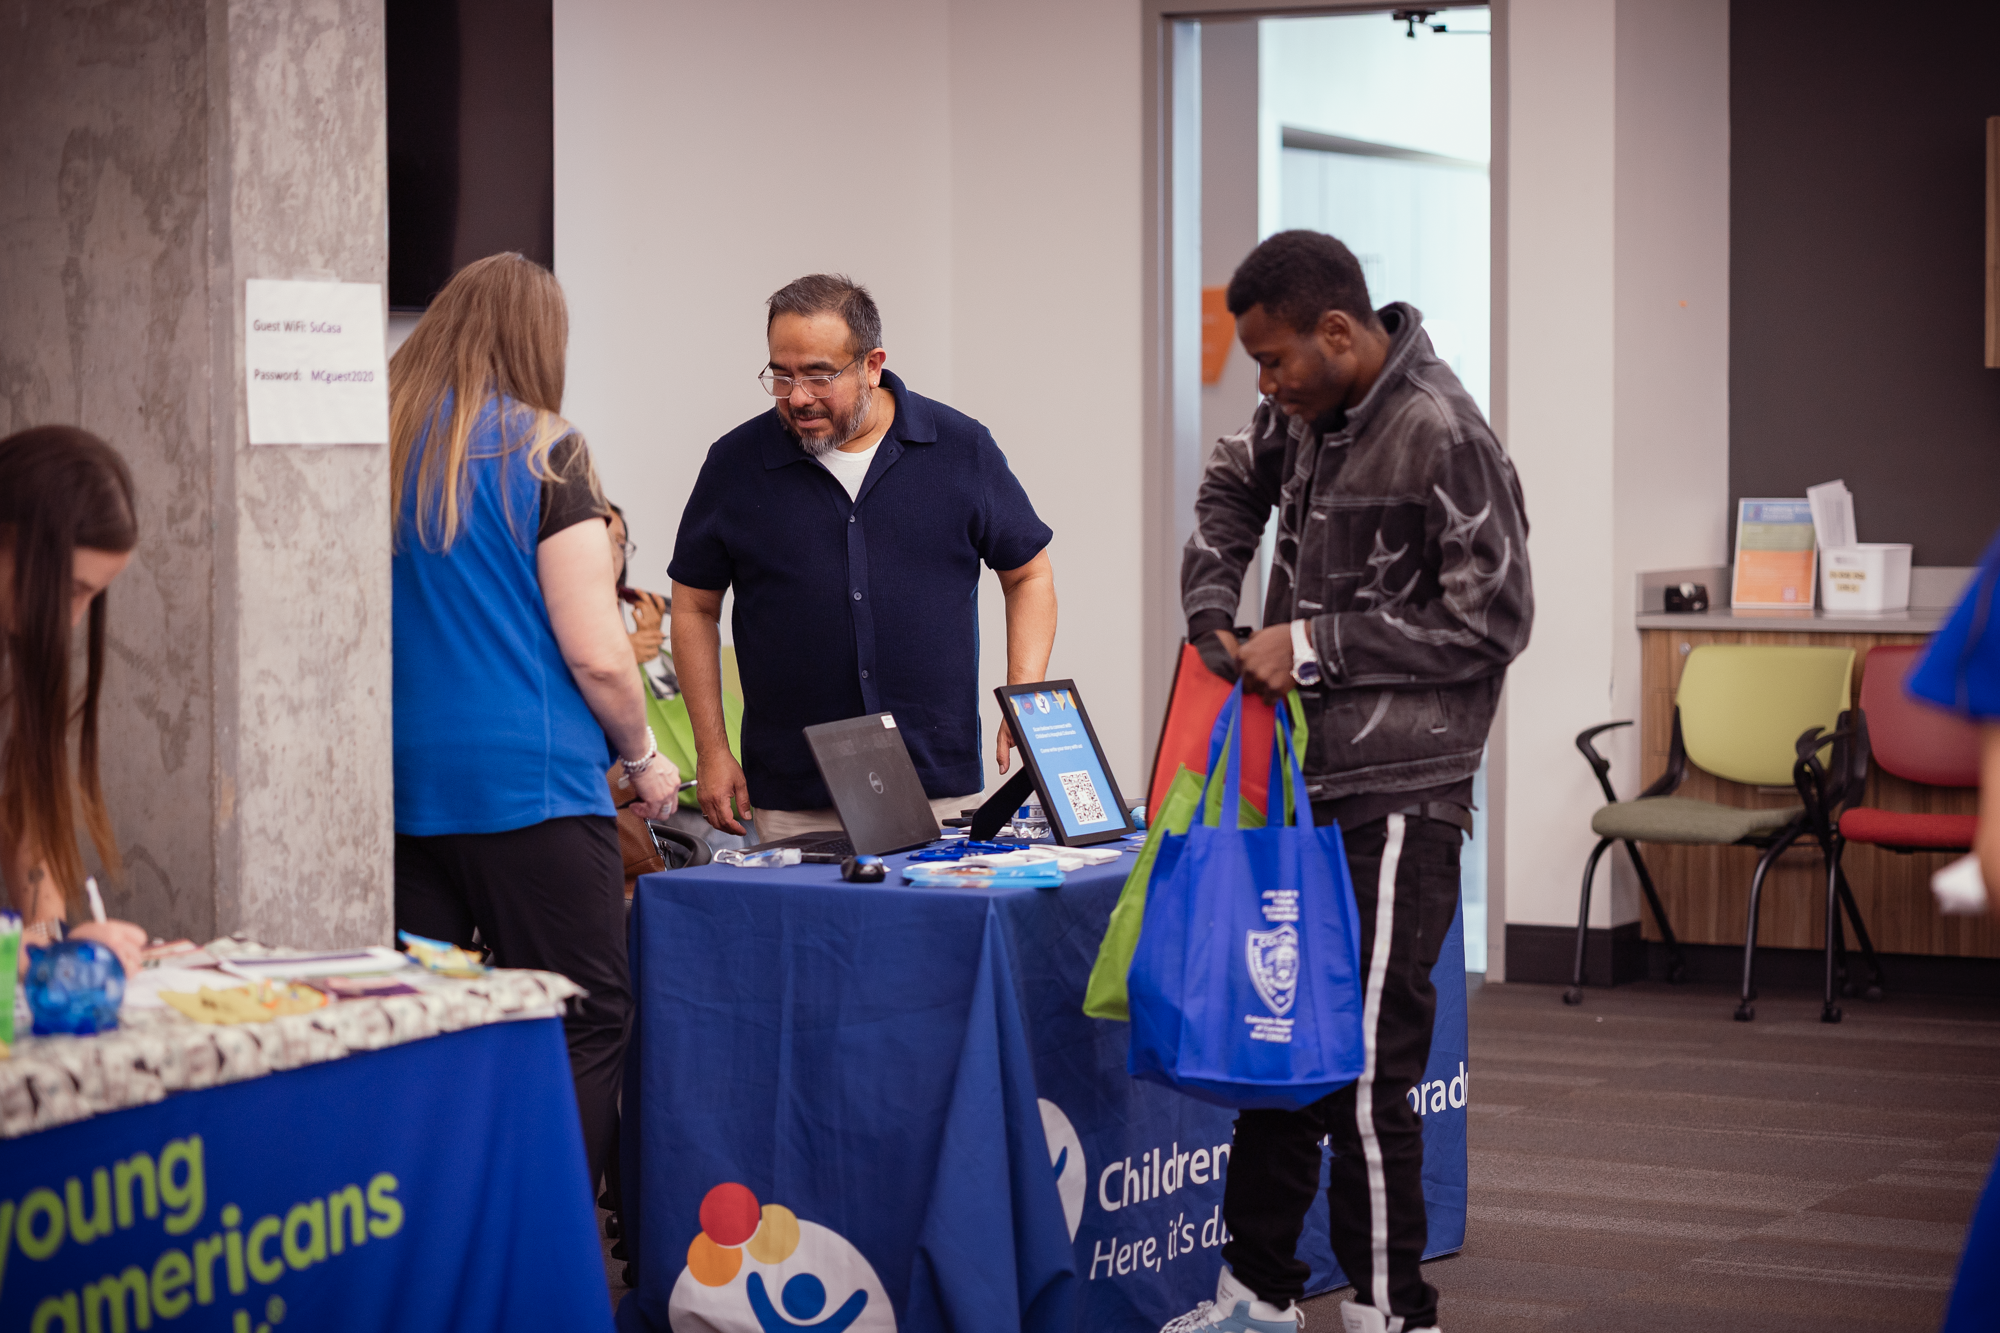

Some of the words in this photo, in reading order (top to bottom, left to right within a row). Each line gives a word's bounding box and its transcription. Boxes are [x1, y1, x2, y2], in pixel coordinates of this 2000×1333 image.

[253, 319, 281, 332] Guest
[310, 321, 342, 334] SuCasa
[254, 368, 302, 382] Password:
[311, 370, 374, 384] MCguest2020
[1099, 1141, 1232, 1212] Children
[29, 1171, 406, 1333] americans
[1089, 1236, 1162, 1281] Here,
[1167, 1212, 1195, 1261] it's
